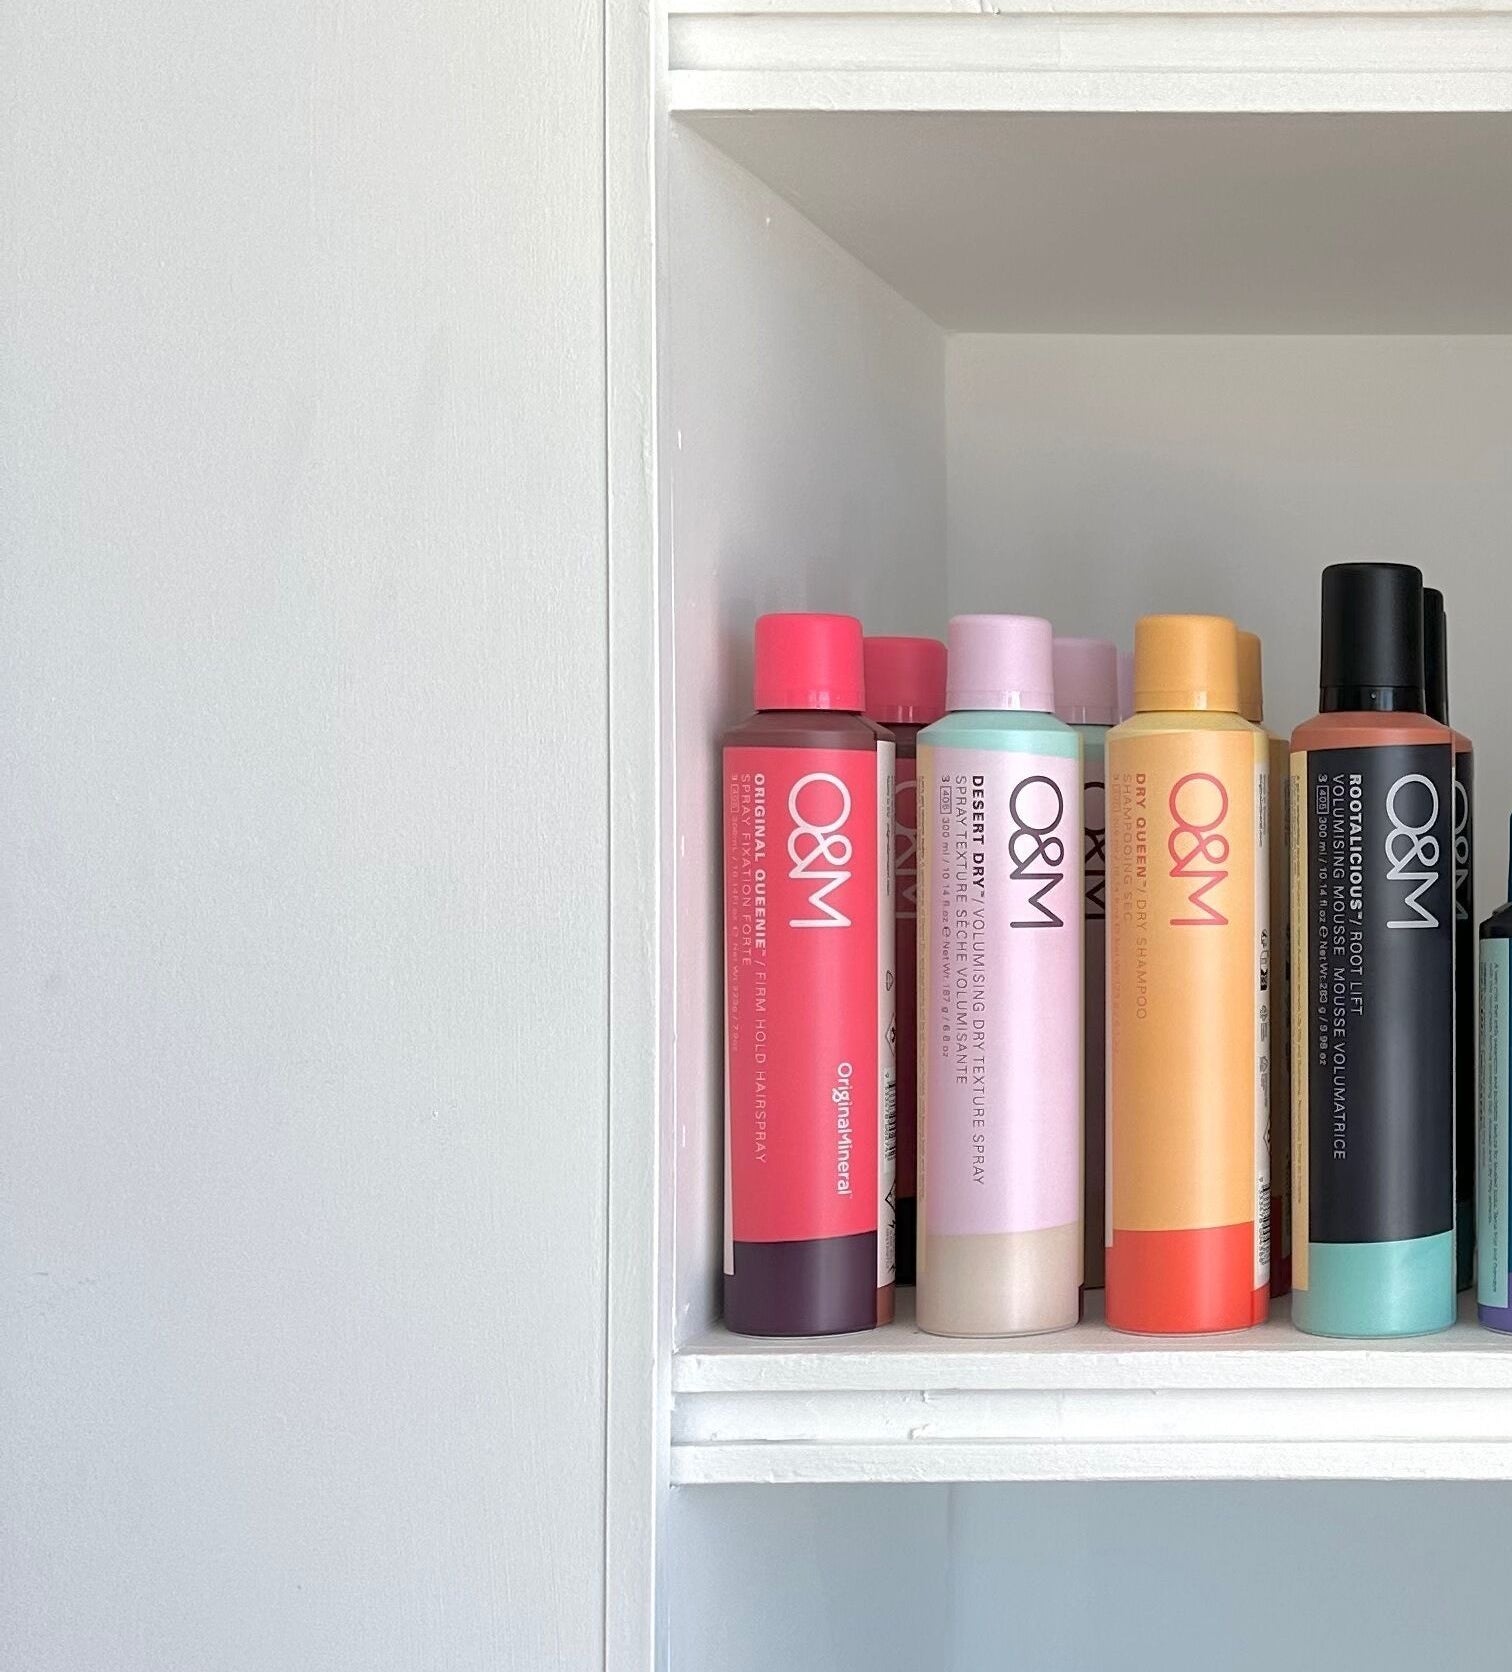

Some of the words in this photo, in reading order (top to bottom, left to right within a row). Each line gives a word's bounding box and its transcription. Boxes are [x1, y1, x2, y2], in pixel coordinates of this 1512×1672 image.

[741, 773, 751, 826] SPRAY
[754, 773, 767, 863] ORIGINAL
[956, 775, 967, 826] SPRAY
[972, 775, 985, 845] DESERT
[1136, 773, 1147, 809] DRY
[1333, 774, 1346, 880] VOLUMISING
[787, 772, 853, 928] O&M
[1008, 775, 1065, 929] O&M
[1123, 773, 1133, 885] SHAMPOOING
[1168, 772, 1230, 926] O&M
[1318, 817, 1328, 838] 300
[1349, 774, 1363, 911] ROOTALICIOUS
[1385, 773, 1440, 929] O&M
[741, 833, 751, 907] FIXATION
[956, 831, 967, 903] TEXTURE
[741, 915, 751, 966] FORTE
[1136, 899, 1147, 930] DRY
[1333, 886, 1346, 956] MOUSSE
[972, 908, 985, 1012] VOLUMISING
[1136, 936, 1147, 1019] SHAMPOO
[1349, 931, 1363, 976] ROOT
[754, 972, 767, 1011] FIRM
[956, 967, 967, 1084] VOLUMISANTE
[1333, 967, 1346, 1038] MOUSSE
[1349, 981, 1363, 1016] LIFT
[754, 1020, 767, 1064] HOLD
[972, 1020, 985, 1050] DRY
[754, 1071, 767, 1163] HAIRSPRAY
[972, 1056, 985, 1128] TEXTURE
[1333, 1043, 1346, 1160] VOLUMATRICE
[972, 1134, 985, 1185] SPRAY
